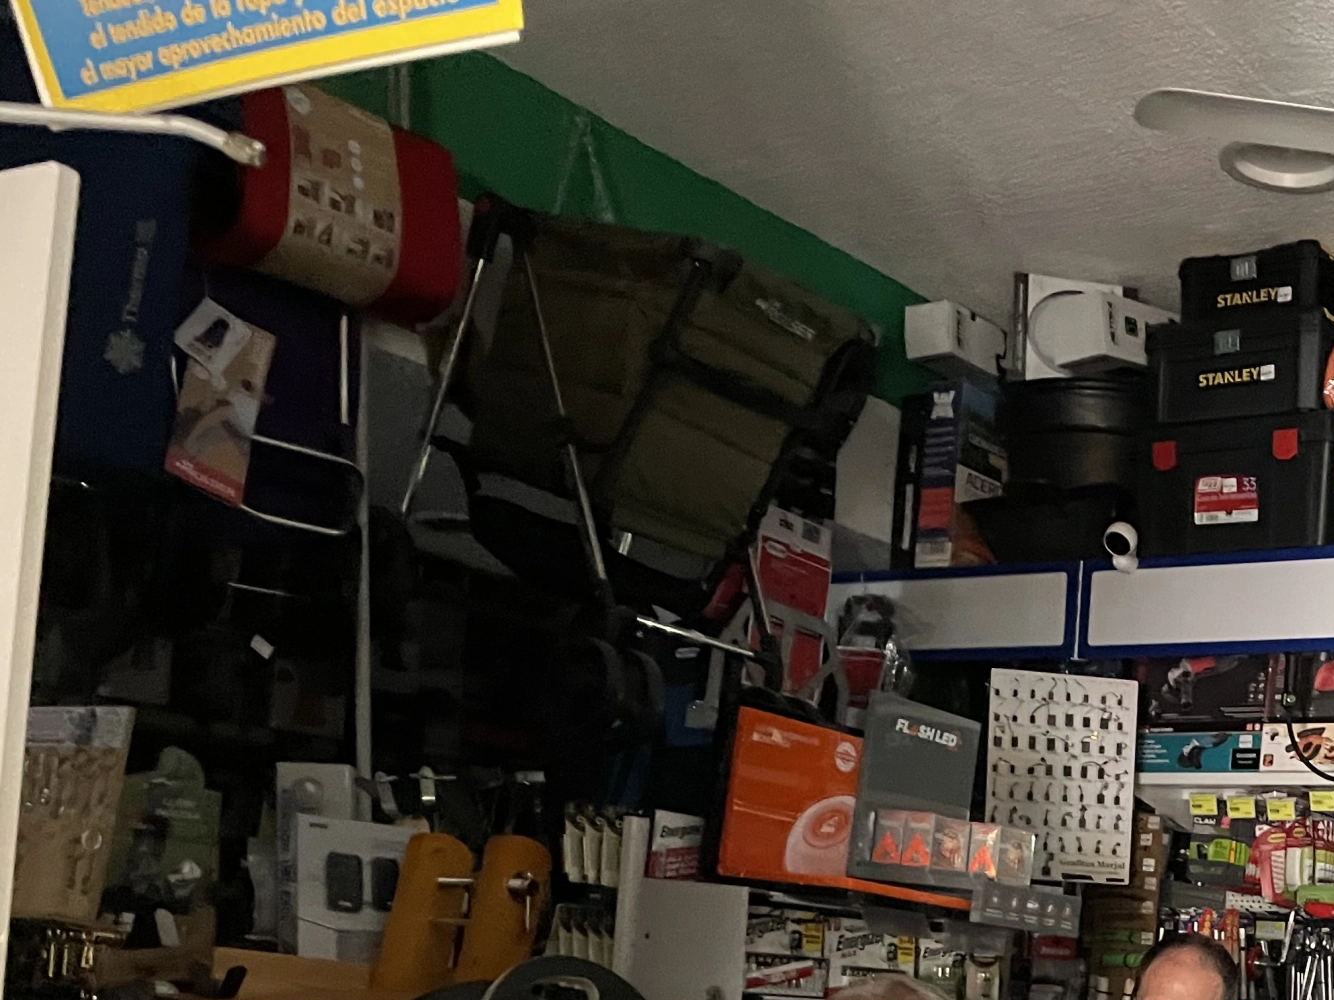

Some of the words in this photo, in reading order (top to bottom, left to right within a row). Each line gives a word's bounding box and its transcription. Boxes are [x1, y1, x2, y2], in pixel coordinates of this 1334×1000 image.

[99, 51, 153, 82] mayor
[157, 9, 327, 70] aprovechamiento
[332, 0, 368, 26] del
[1217, 287, 1278, 308] STANLEY
[1198, 366, 1260, 388] STANLEY
[936, 728, 960, 749] LED
